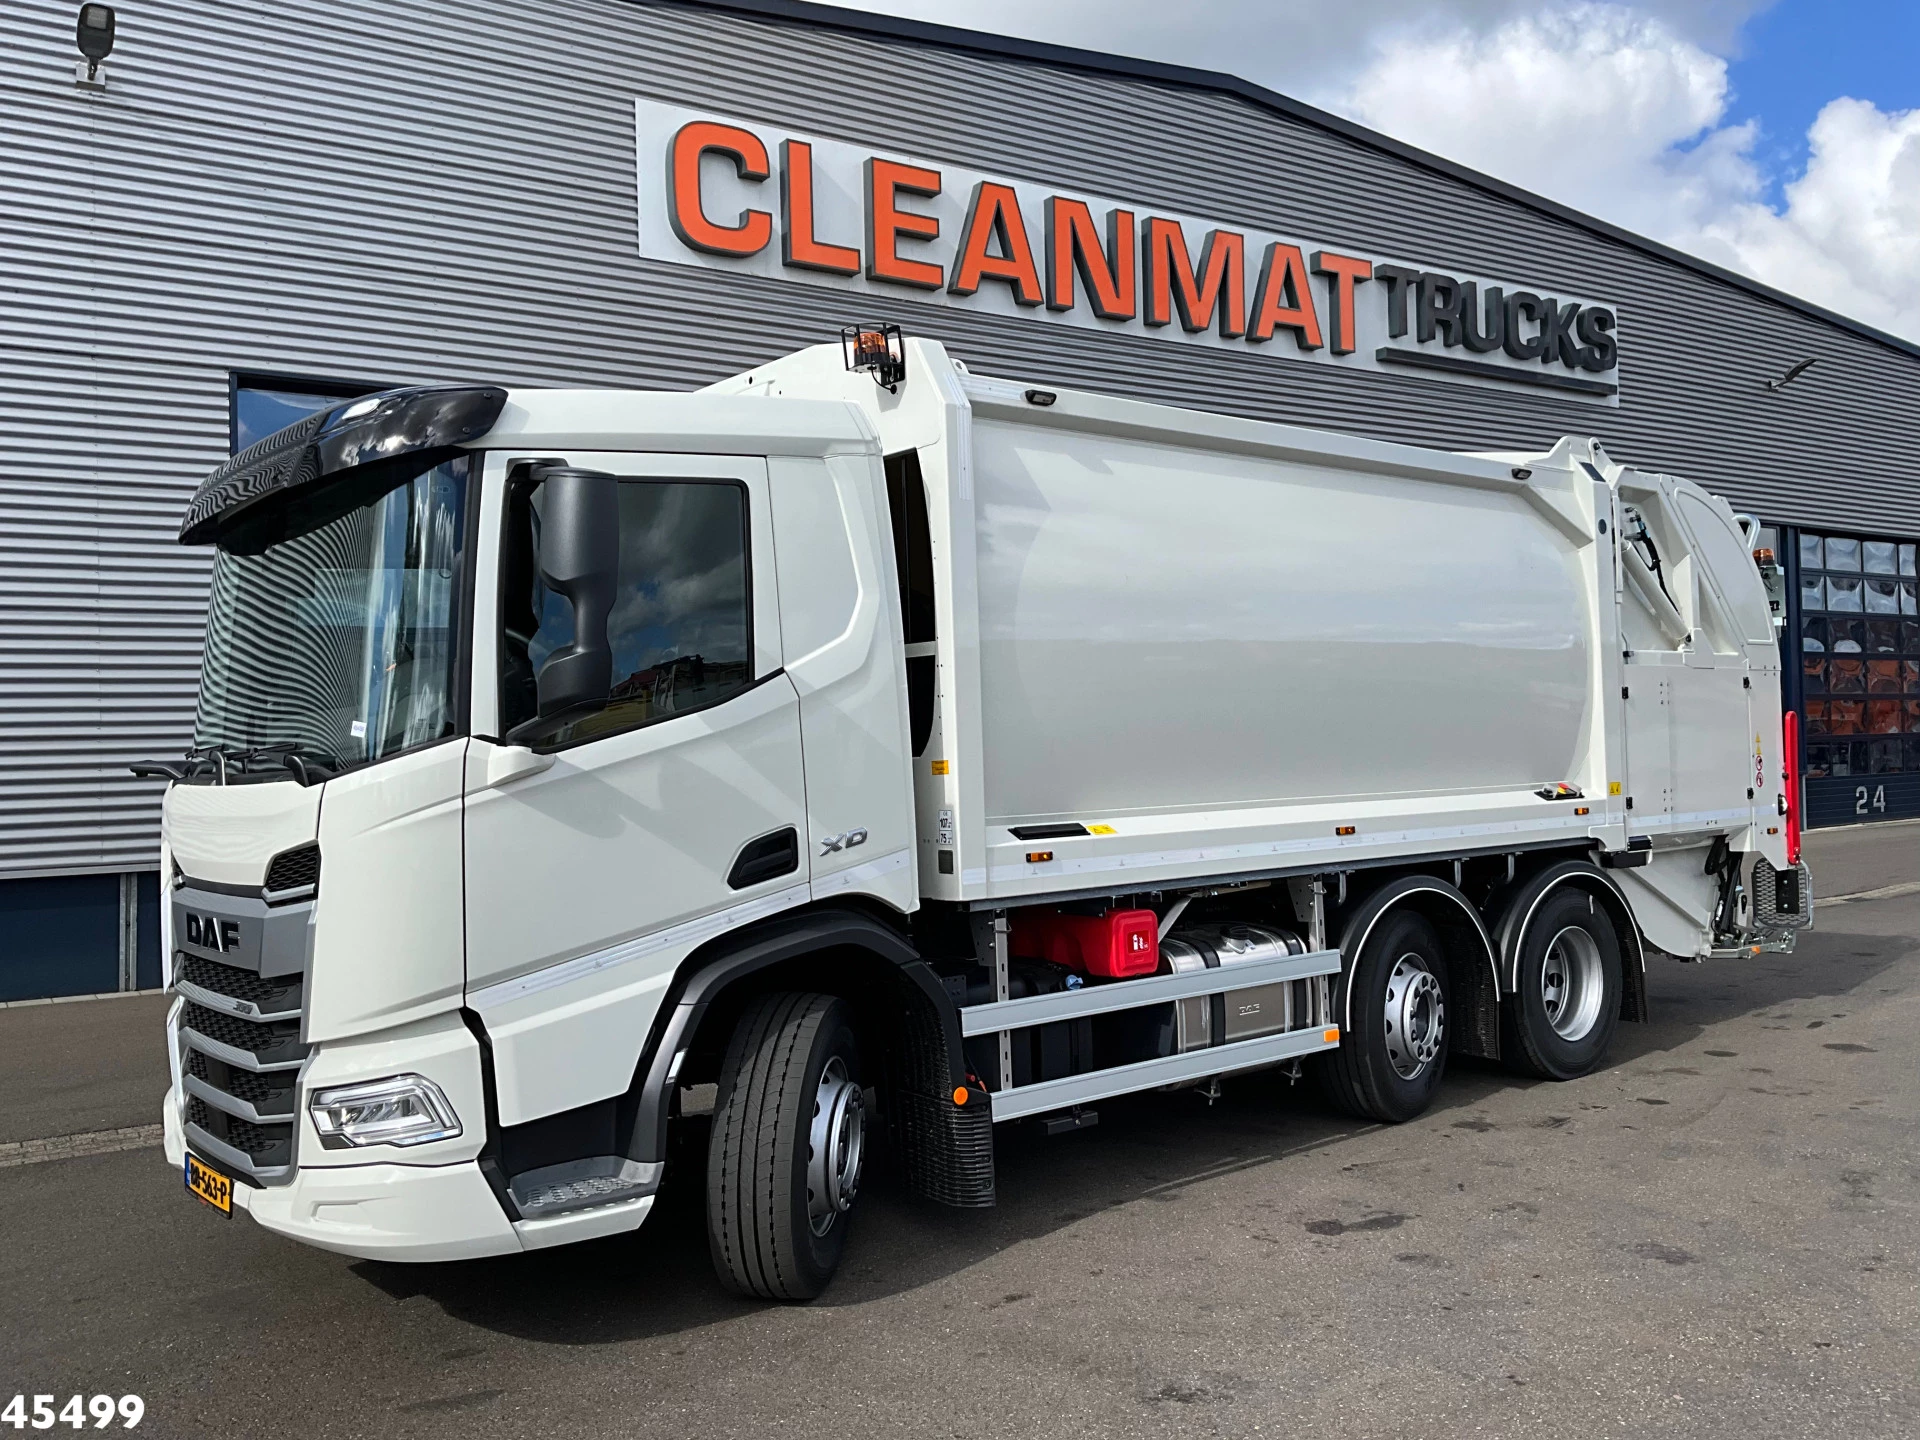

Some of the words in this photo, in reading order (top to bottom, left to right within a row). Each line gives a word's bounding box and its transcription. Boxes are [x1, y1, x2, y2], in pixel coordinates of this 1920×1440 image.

[665, 120, 1372, 356] CLEANMAT
[1374, 263, 1618, 372] TRUCKS
[1856, 785, 1885, 814] 24
[819, 827, 868, 857] XD
[186, 911, 240, 955] DAF
